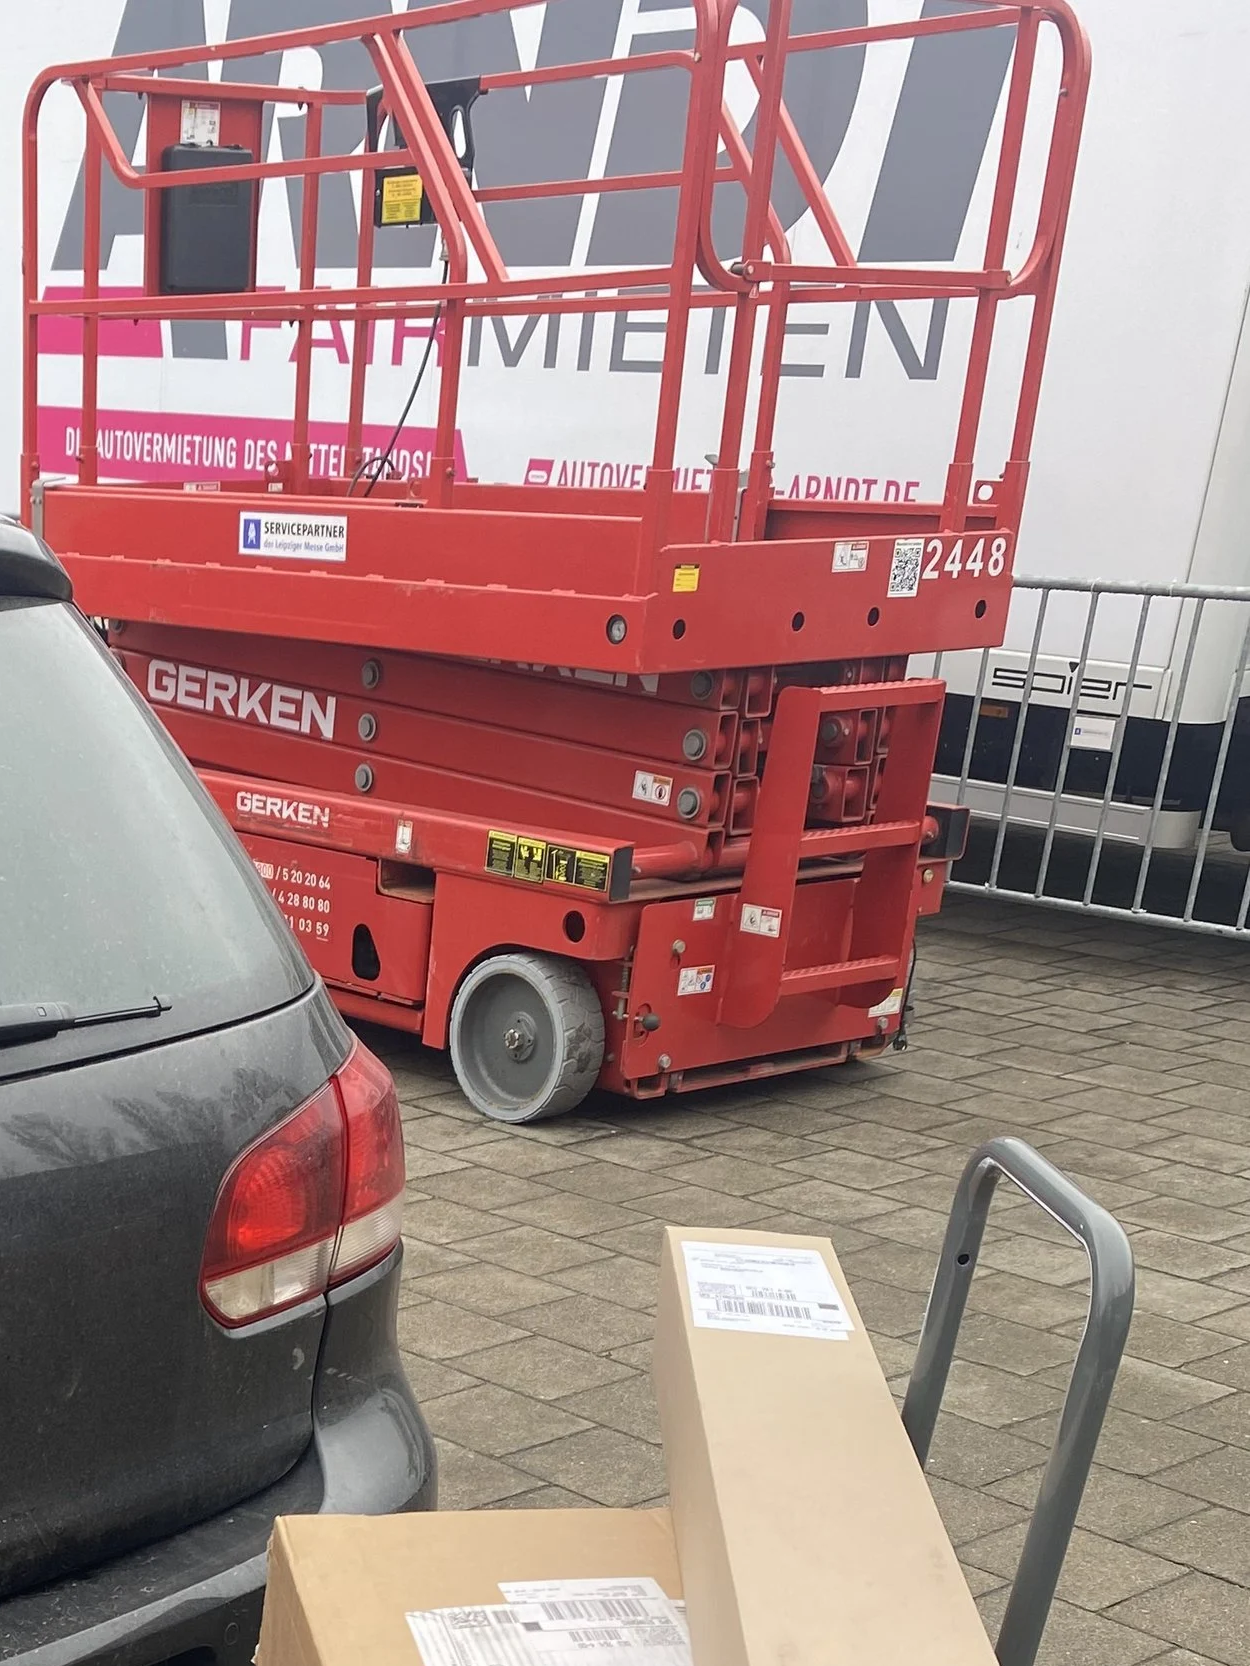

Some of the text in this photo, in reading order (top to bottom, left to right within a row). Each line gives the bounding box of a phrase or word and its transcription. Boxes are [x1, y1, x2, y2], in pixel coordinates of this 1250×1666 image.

[65, 426, 81, 457] DI
[97, 428, 237, 470] AUTOVERMIETUNG
[264, 521, 345, 538] SERVICEPARTNER
[275, 540, 302, 553] Leipziger
[304, 541, 324, 551] Messe
[325, 543, 344, 553] GmbH
[922, 537, 1007, 579] 2448
[147, 658, 338, 741] GERKEN
[236, 791, 330, 828] GERKEN
[282, 868, 289, 881] 5
[290, 870, 303, 884] 20
[304, 873, 317, 887] 20
[318, 875, 331, 890] 64
[278, 890, 285, 904] 4
[287, 892, 300, 907] 28
[302, 895, 315, 910] 80
[317, 898, 330, 914] 80
[298, 918, 312, 933] 03
[316, 921, 329, 937] 59
